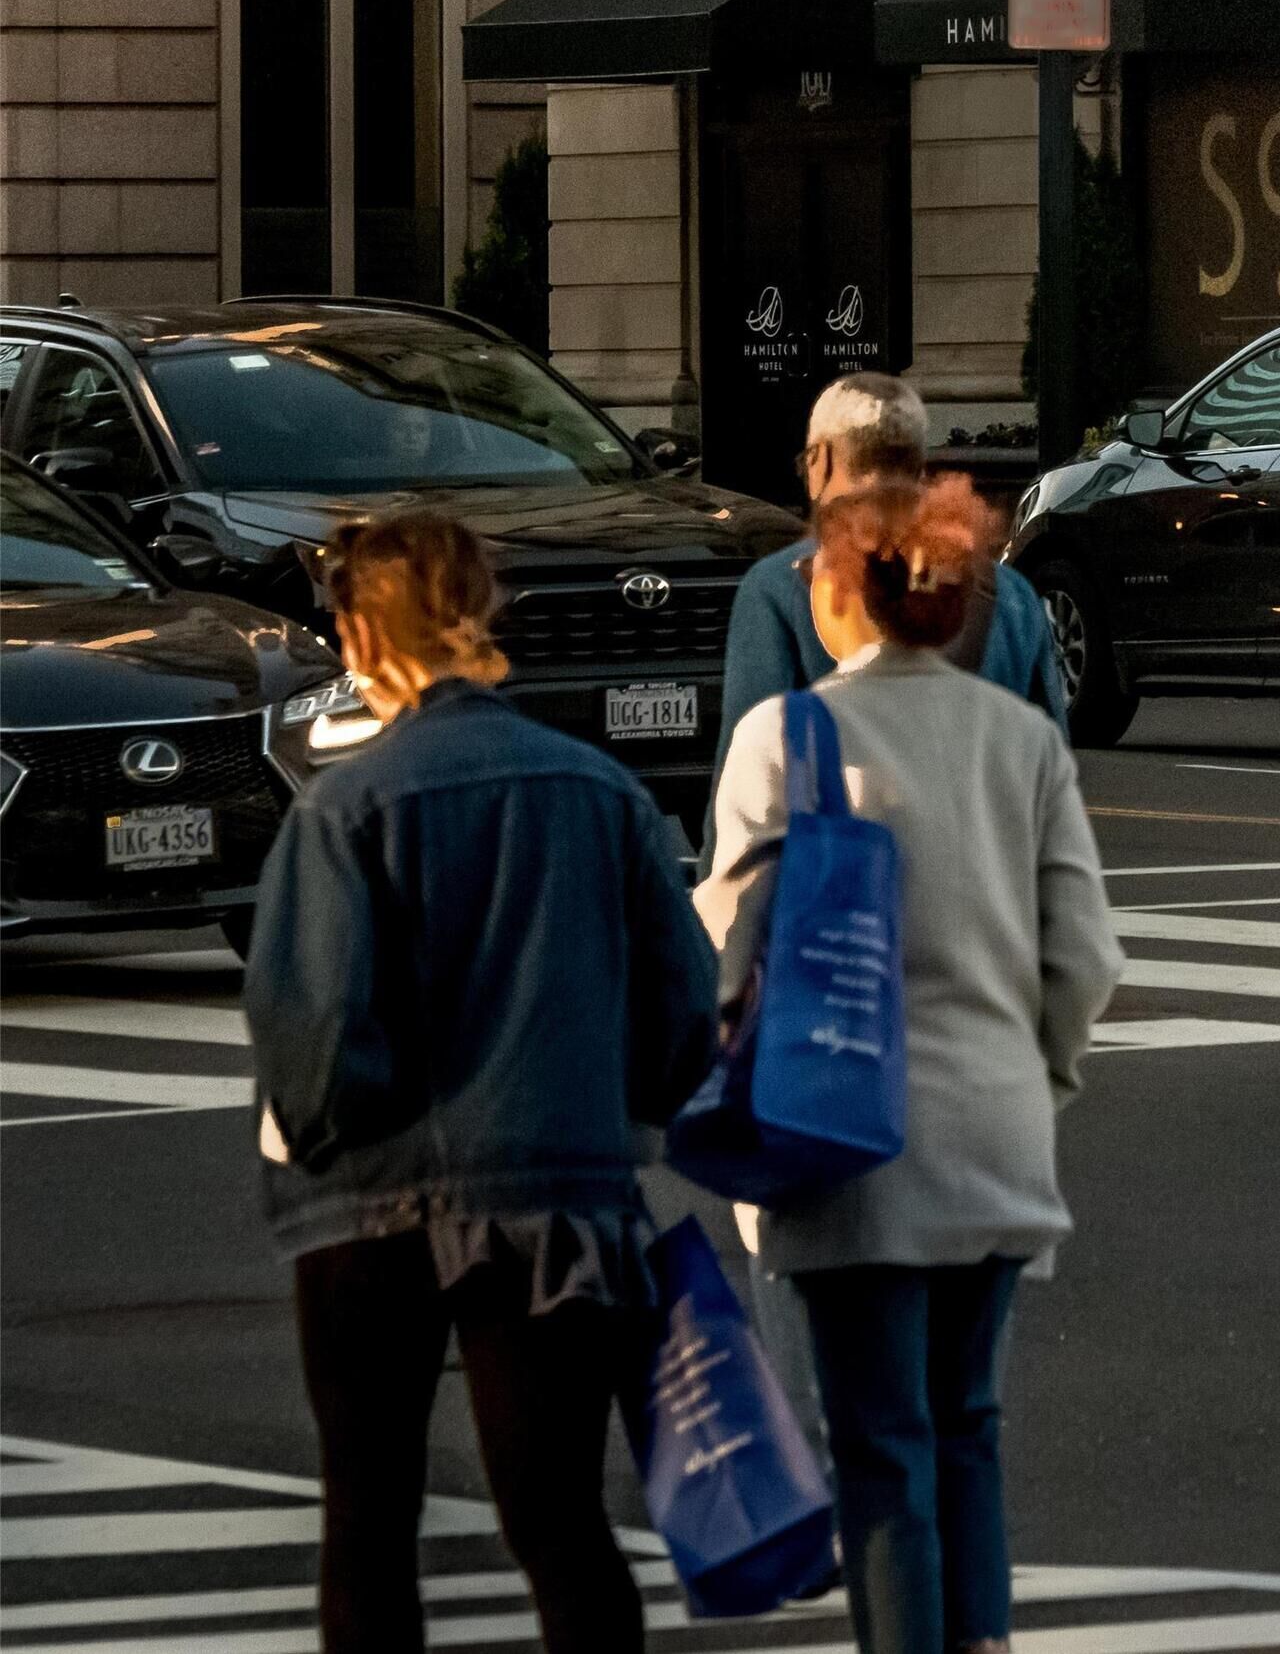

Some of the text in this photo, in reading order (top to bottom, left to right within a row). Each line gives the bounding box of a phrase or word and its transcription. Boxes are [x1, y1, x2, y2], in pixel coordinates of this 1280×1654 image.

[824, 343, 878, 355] HAMILTON
[759, 362, 782, 371] HOTEL
[839, 361, 862, 371] HOTEL
[610, 698, 694, 726] UGG-1814
[662, 729, 694, 737] TOYOTA
[112, 820, 209, 855] UKG-4356
